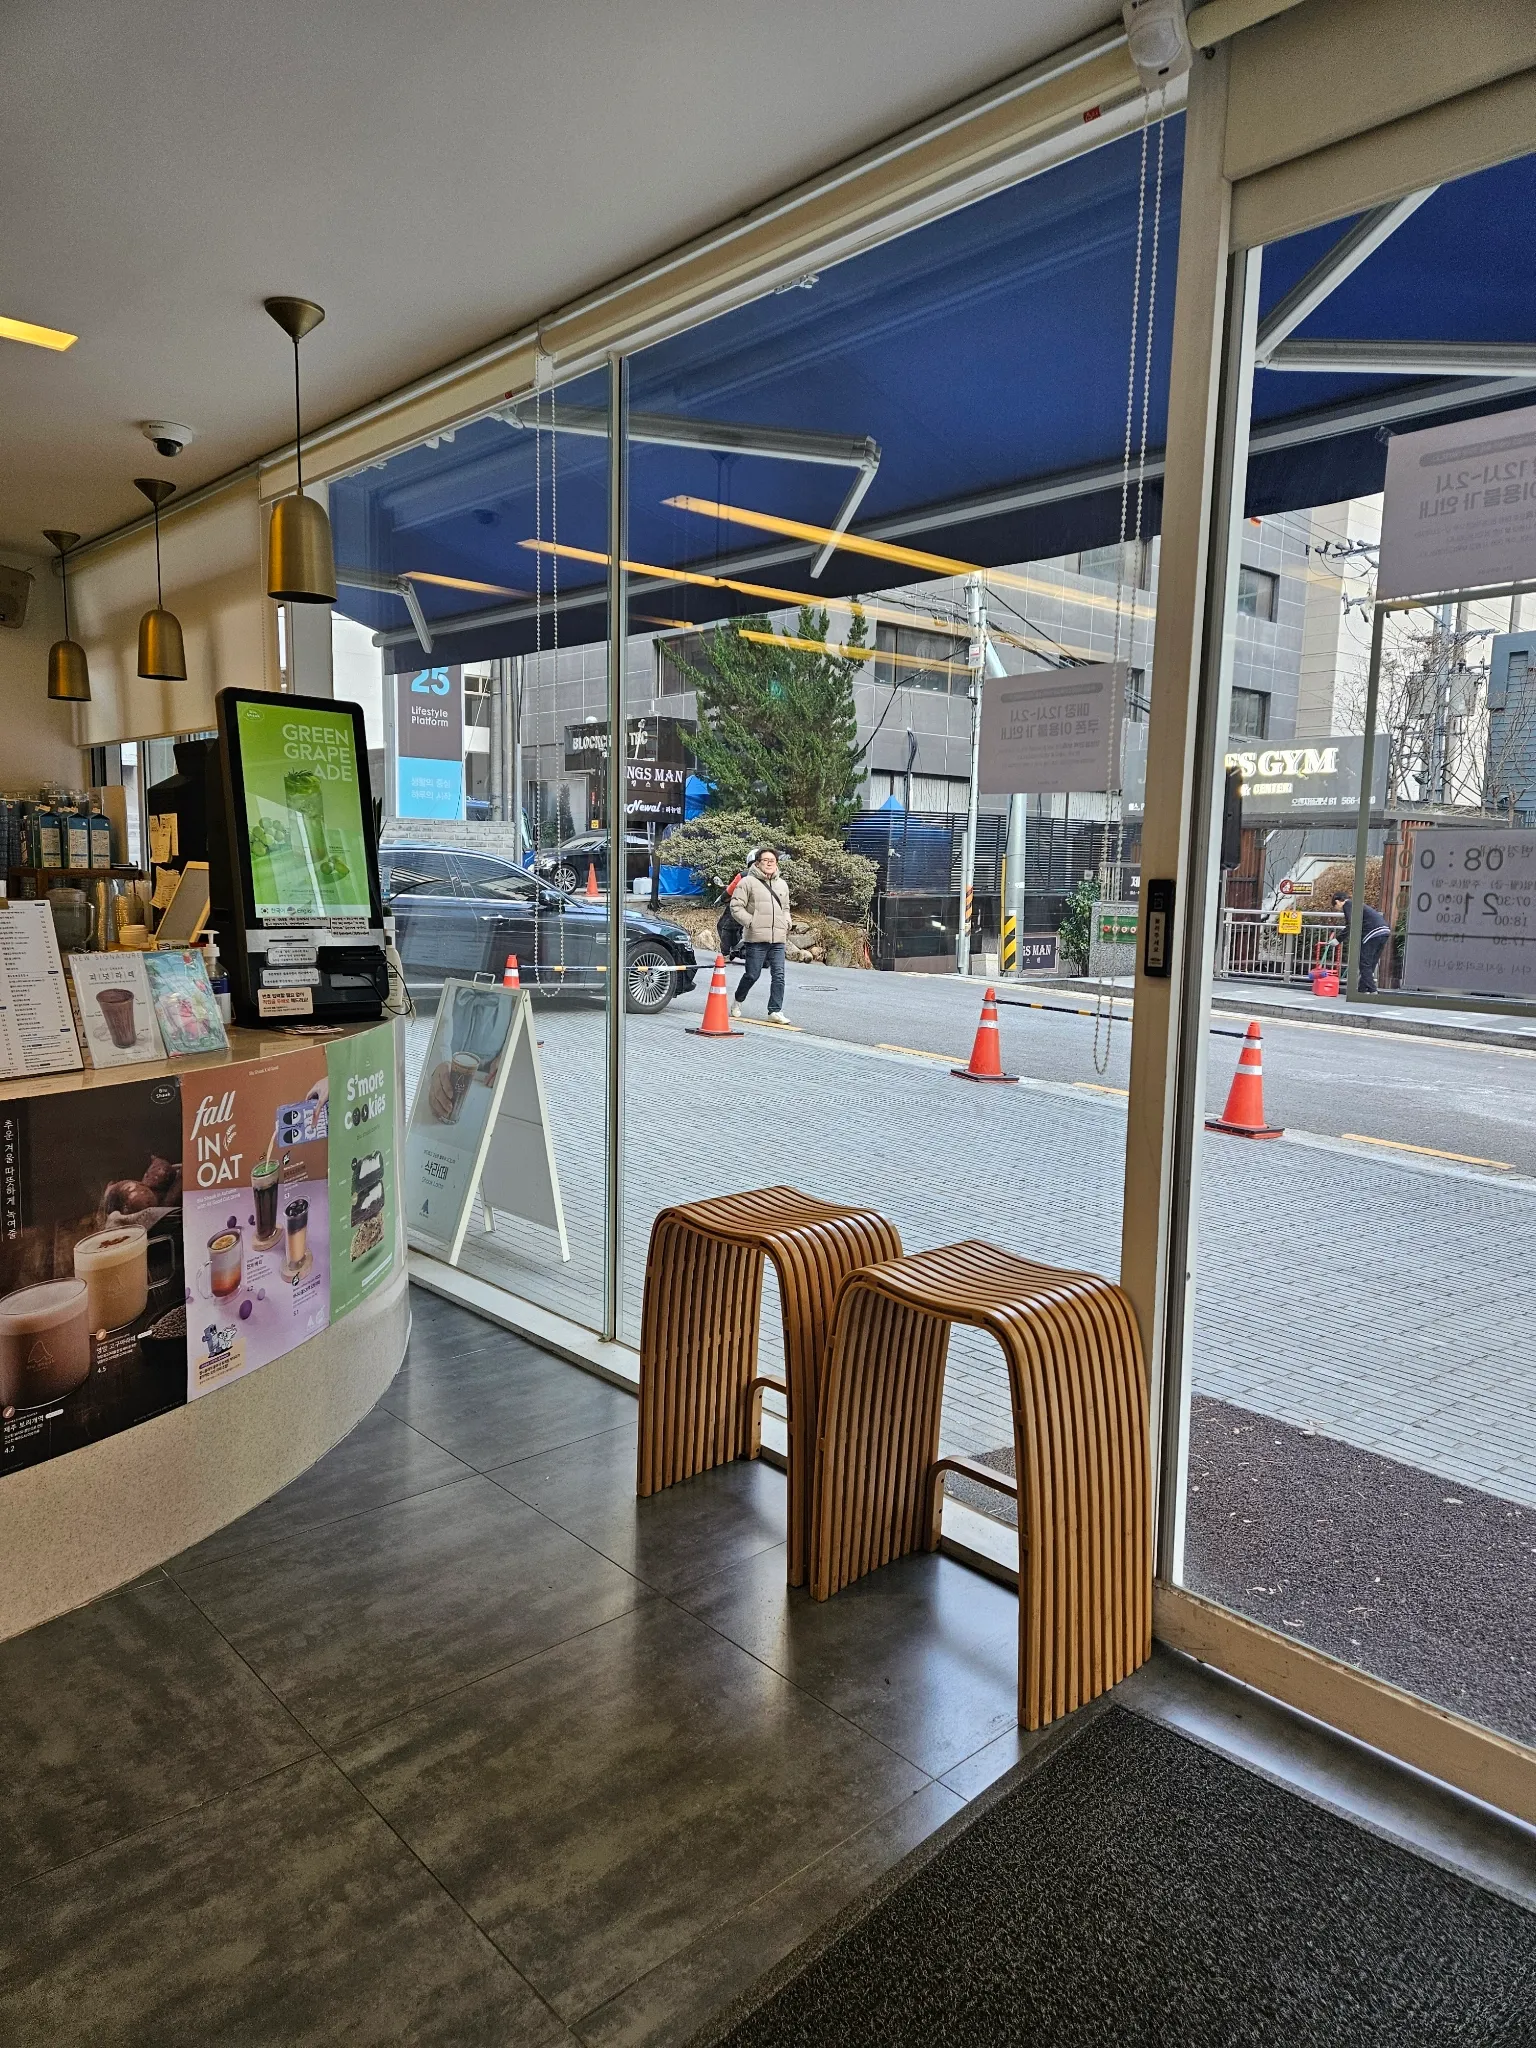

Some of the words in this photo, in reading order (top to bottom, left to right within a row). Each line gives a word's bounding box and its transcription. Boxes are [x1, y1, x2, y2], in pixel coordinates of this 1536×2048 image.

[411, 705, 448, 720] Lifestyle
[411, 715, 449, 728] Platform
[282, 724, 349, 746] GREEN
[283, 742, 351, 764] GRAPE
[313, 762, 353, 782] ADE
[654, 768, 684, 783] MAN
[71, 954, 91, 962] NEW
[95, 952, 142, 962] SIGNATURE
[1032, 944, 1052, 956] MAN
[190, 1090, 237, 1141] fall
[3, 1119, 14, 1142] 추운
[199, 1134, 221, 1163] IN
[196, 1153, 243, 1189] OAT
[4, 1445, 15, 1454] 4.2
